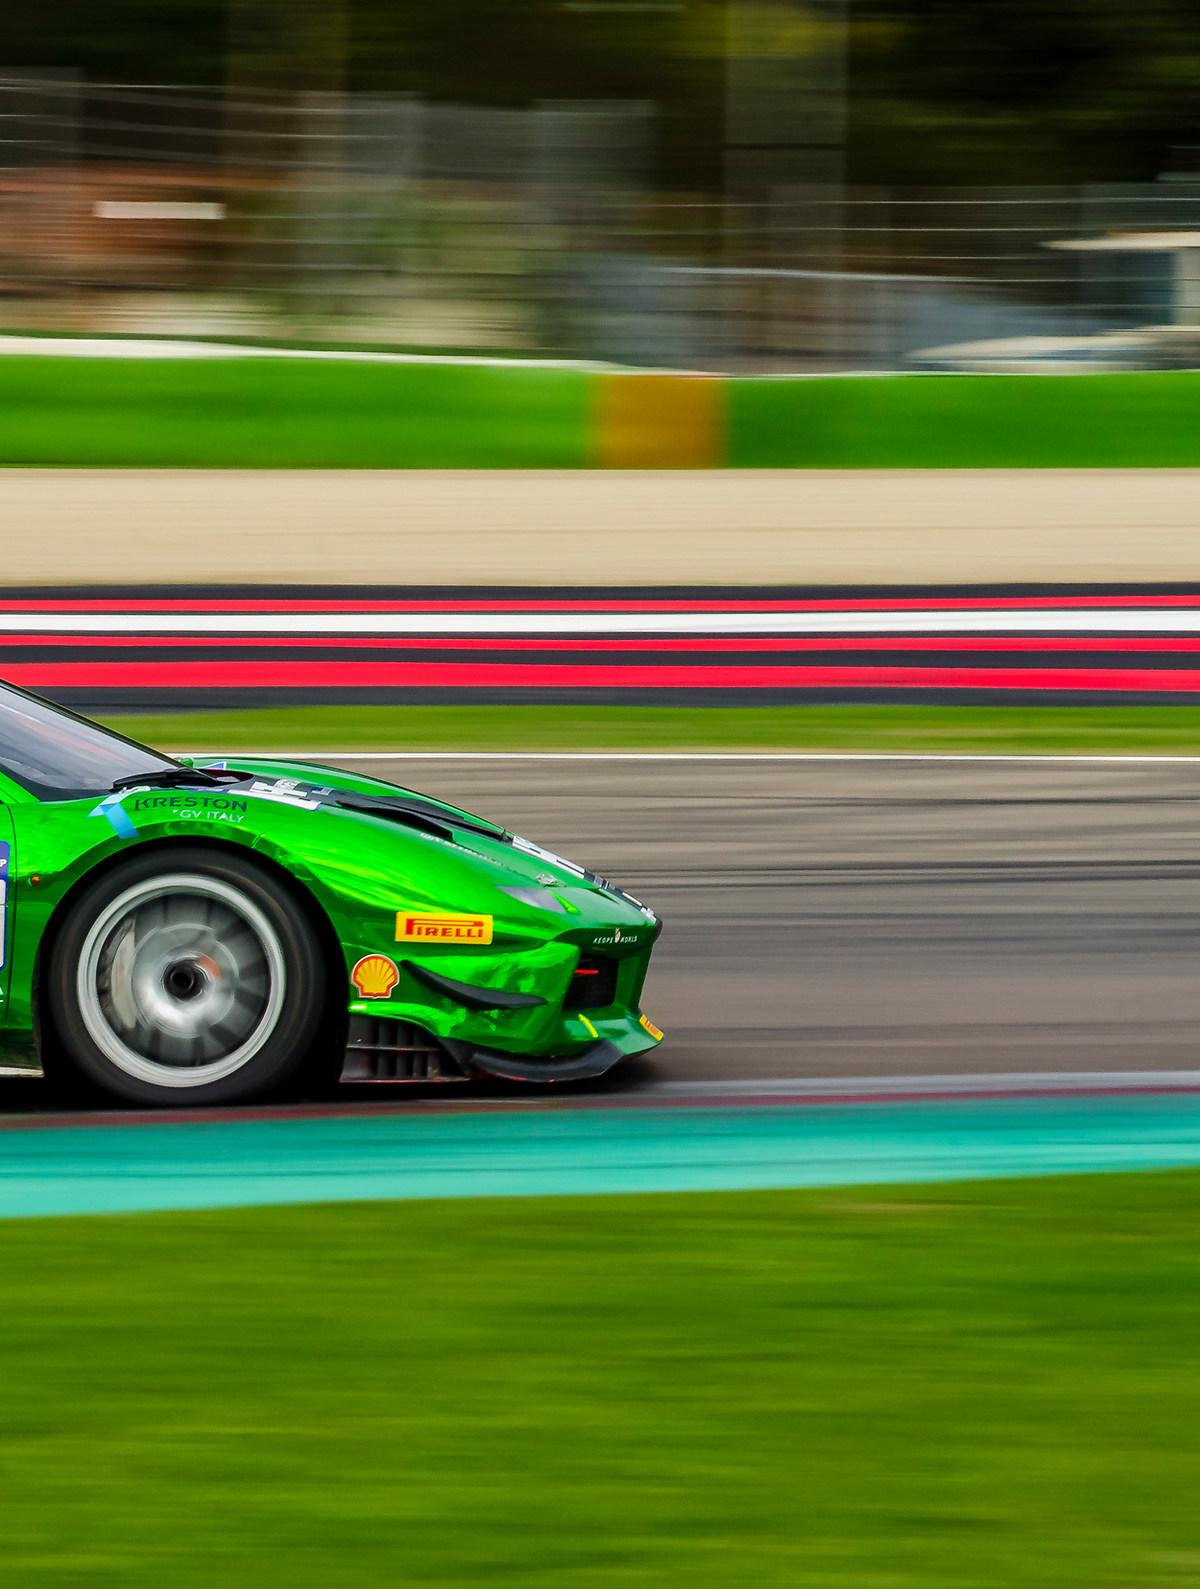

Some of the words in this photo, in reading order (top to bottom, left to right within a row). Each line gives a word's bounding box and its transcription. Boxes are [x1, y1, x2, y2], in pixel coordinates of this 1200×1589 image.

[134, 796, 248, 813] KRESTON
[179, 809, 202, 819] GV
[207, 811, 245, 823] ITALY
[405, 917, 485, 939] PIRELLI
